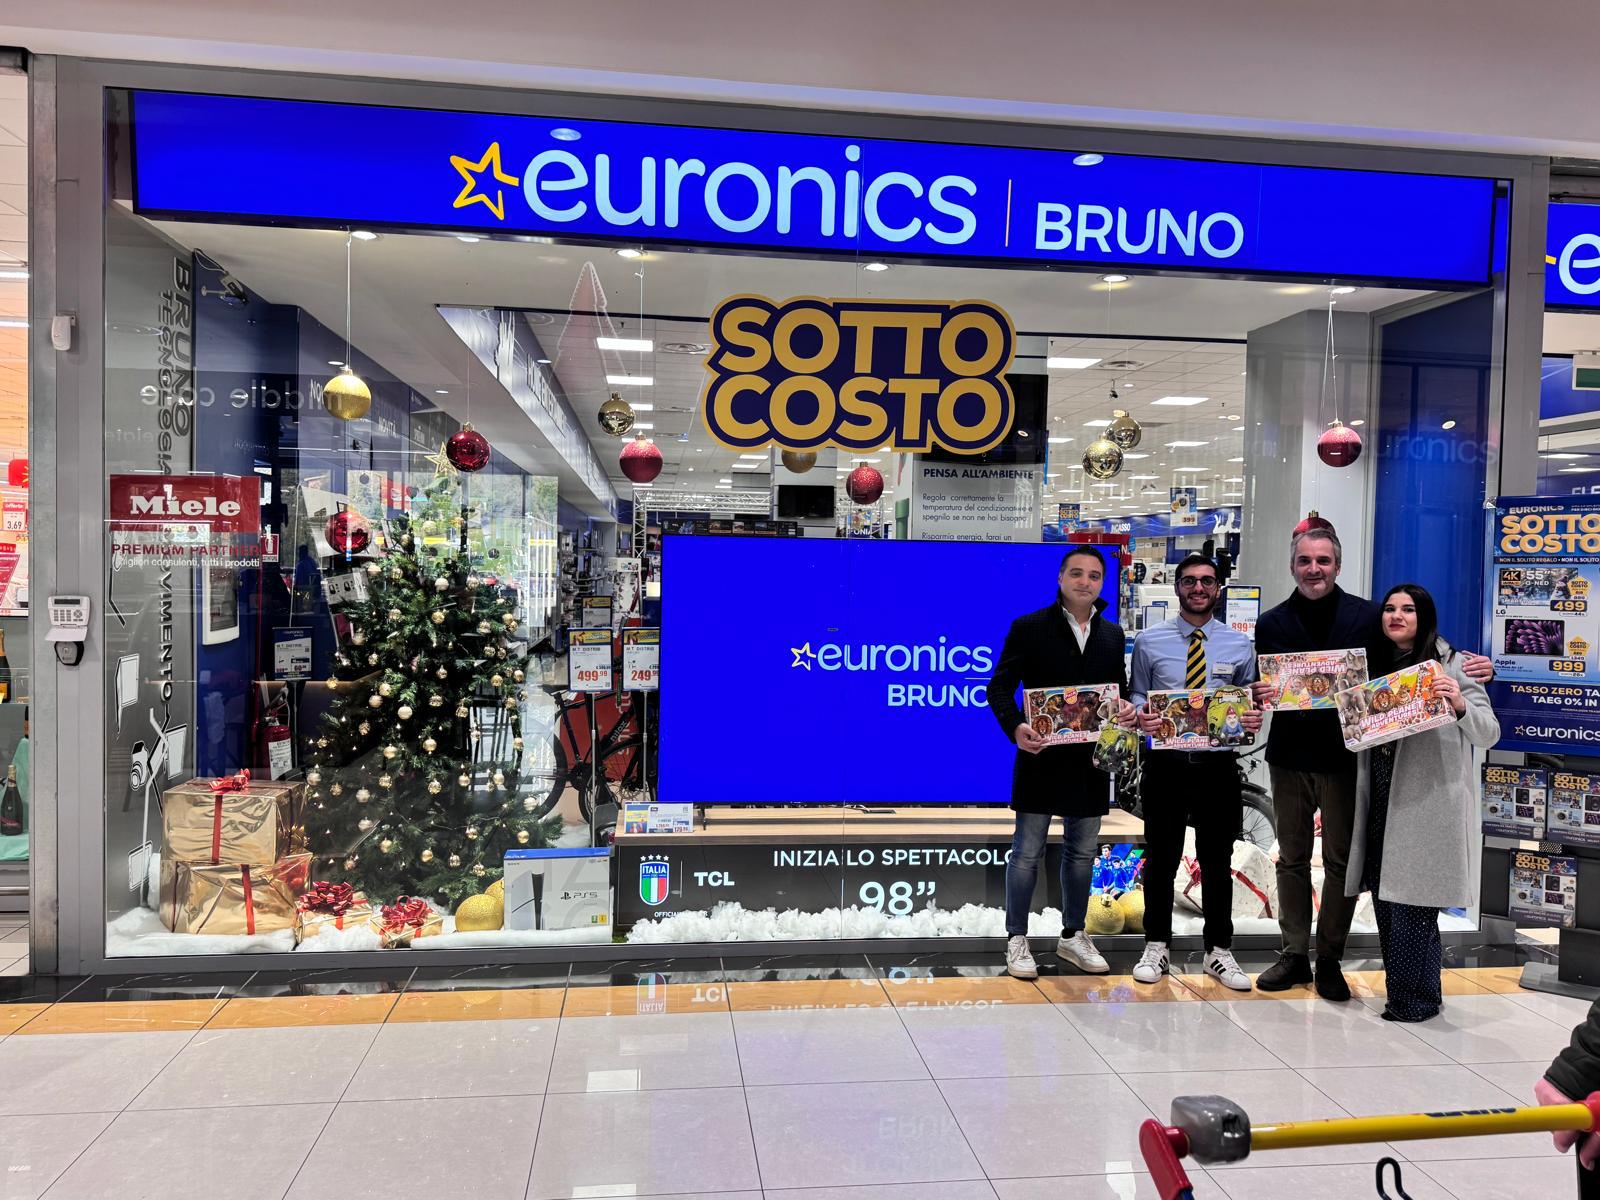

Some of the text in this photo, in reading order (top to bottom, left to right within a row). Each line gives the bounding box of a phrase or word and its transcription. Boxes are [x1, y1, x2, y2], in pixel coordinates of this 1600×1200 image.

[523, 144, 978, 246] euronics
[1034, 202, 1245, 259] BRUNO
[173, 256, 191, 436] BRUNO
[718, 306, 1005, 377] SOTTO
[713, 374, 1003, 443] COSTO
[923, 468, 1034, 480] PENSA ALL'AMBIENTE
[922, 493, 1004, 503] Regola correttamente la
[130, 494, 241, 516] Miele
[922, 503, 963, 513] temperatura
[964, 503, 975, 512] del
[1508, 505, 1565, 515] EURONICS
[922, 513, 951, 523] spegnilo
[987, 513, 999, 521] hai
[1501, 513, 1600, 534] SOTTO
[921, 531, 955, 542] Risparmia
[985, 532, 1002, 541] farai
[1500, 533, 1600, 554] COSTO
[111, 543, 260, 557] PREMIUM PARTNER
[224, 558, 260, 569] prodotti
[1503, 571, 1519, 580] 4K
[1554, 600, 1586, 611] 499
[817, 635, 993, 673] euronics
[1552, 660, 1584, 672] 999
[1511, 684, 1549, 694] TASSO
[1551, 687, 1583, 696] ZERO
[1531, 695, 1598, 707] TAEG 0% IN
[1360, 699, 1425, 727] WILD PLANET
[1525, 725, 1600, 741] euronics
[1486, 768, 1519, 778] SOTTO
[1486, 775, 1520, 784] COSTO
[1555, 774, 1590, 785] SOTTO
[1554, 781, 1590, 791] COSTO
[773, 850, 840, 867] INIZIA
[846, 849, 875, 866] LO
[1516, 853, 1550, 865] SOTTO
[642, 865, 667, 874] ITALIA
[1515, 860, 1550, 872] COSTO
[693, 870, 735, 887] TCL
[573, 891, 598, 899] PS5
